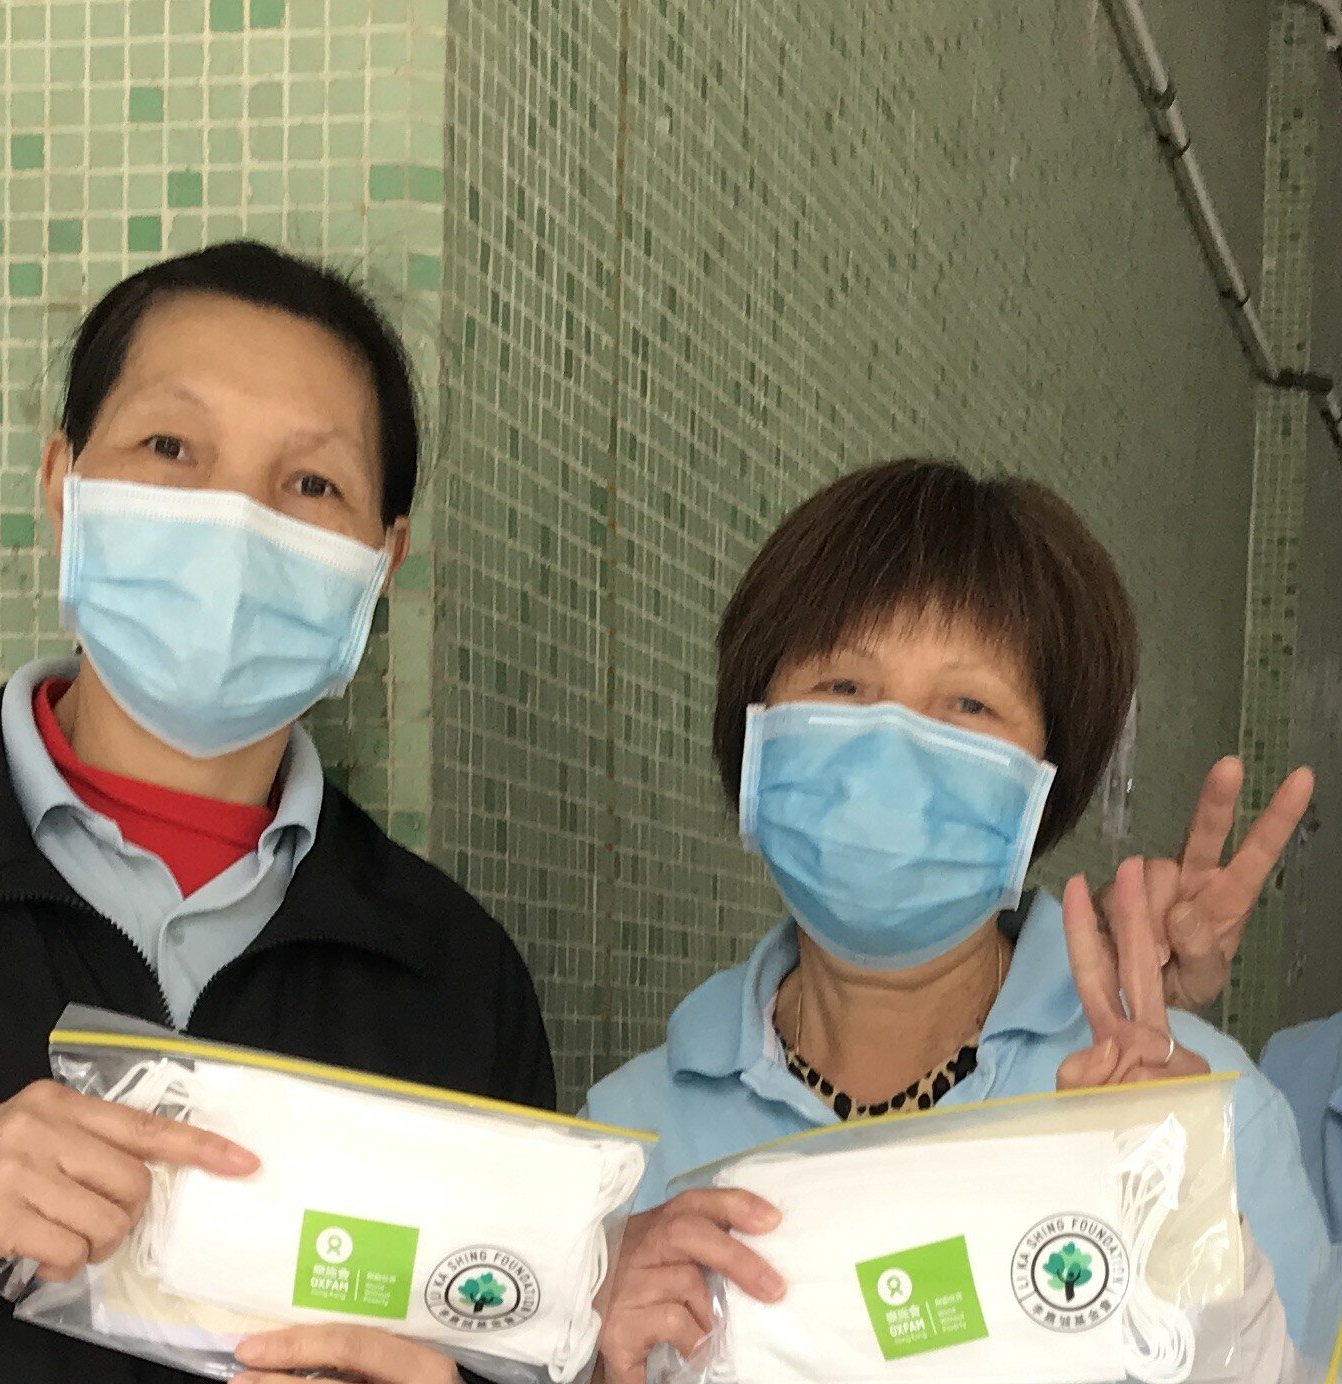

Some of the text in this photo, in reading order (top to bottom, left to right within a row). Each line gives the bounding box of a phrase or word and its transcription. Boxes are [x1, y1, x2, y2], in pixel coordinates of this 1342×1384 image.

[1026, 1219, 1065, 1250] SHING
[310, 1276, 349, 1292] OXFAM
[447, 1250, 488, 1272] SHING
[493, 1251, 536, 1313] FOUNDATION
[889, 1317, 926, 1338] OXFAM
